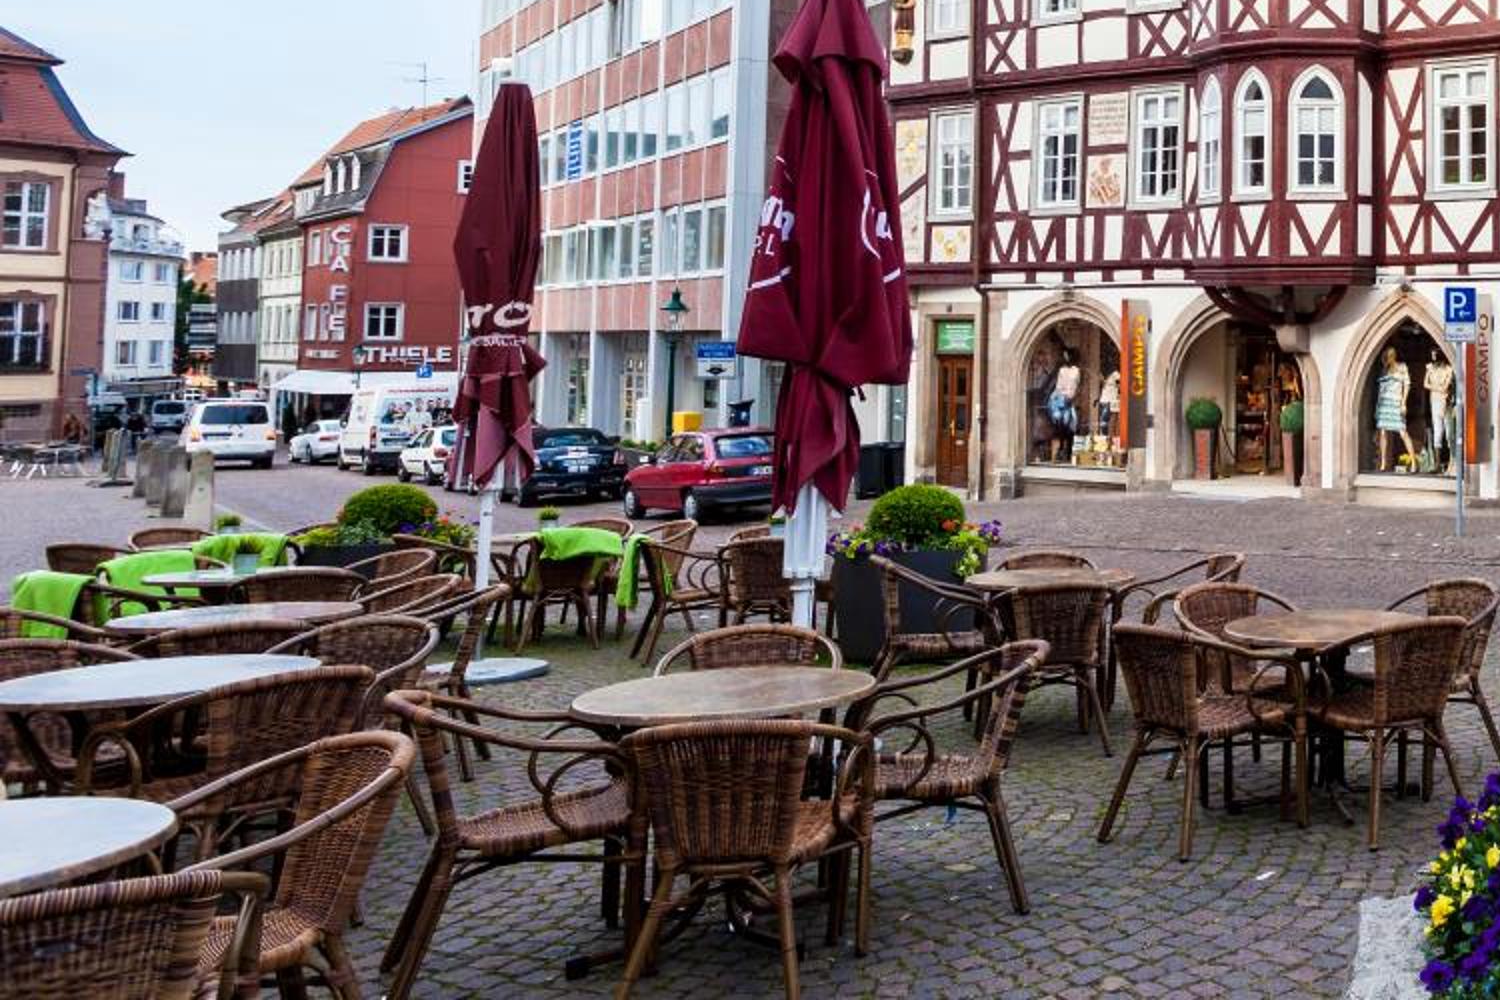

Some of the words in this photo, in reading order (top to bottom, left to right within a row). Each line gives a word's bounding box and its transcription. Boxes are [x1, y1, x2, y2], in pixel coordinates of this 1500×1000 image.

[1449, 291, 1467, 319] P
[362, 346, 453, 363] THIELE
[1477, 313, 1489, 403] CAMPO
